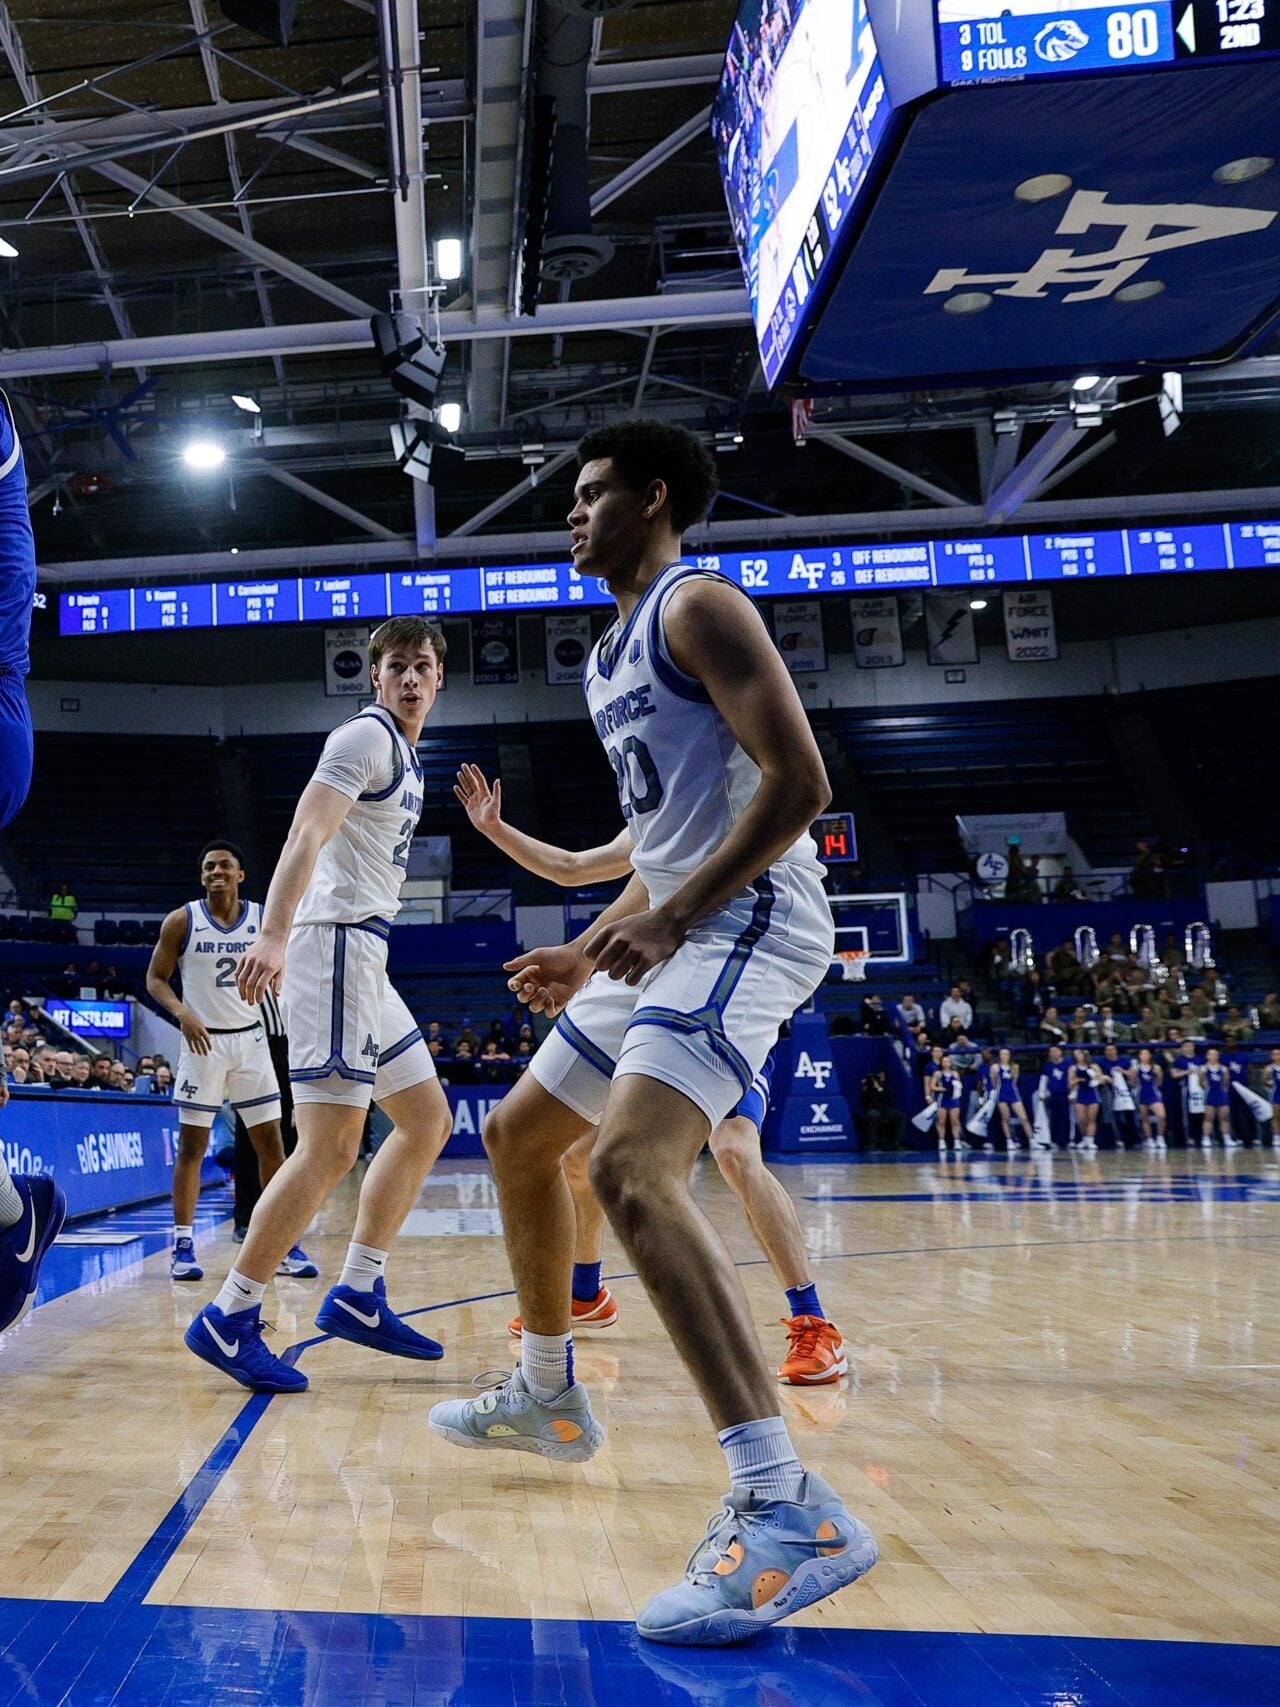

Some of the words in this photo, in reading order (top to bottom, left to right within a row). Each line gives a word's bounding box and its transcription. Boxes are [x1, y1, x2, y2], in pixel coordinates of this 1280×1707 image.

[958, 24, 971, 46] 3
[976, 22, 1007, 45] TOL
[1106, 9, 1159, 59] 80
[1220, 23, 1261, 50] 2ND
[960, 51, 974, 72] 9
[978, 46, 1028, 71] FOULS
[833, 552, 841, 566] 3
[853, 551, 873, 564] OFF
[872, 547, 926, 563] REBOUNDS
[486, 572, 506, 585] OFF
[505, 569, 556, 584] REBOUNDS
[740, 559, 769, 588] 52
[787, 554, 826, 590] AF
[855, 569, 873, 583] DEF
[875, 566, 929, 582] REBOUNDS
[488, 590, 505, 604] DEF
[507, 587, 558, 603] REBOUNDS
[777, 613, 819, 623] FORCE
[852, 608, 894, 618] FORCE
[1008, 605, 1050, 618] FORCE
[326, 639, 368, 648] FORCE
[474, 628, 514, 637] FORCE
[606, 684, 657, 732] FORCE
[824, 832, 848, 856] 14
[194, 942, 215, 954] AIR
[218, 940, 255, 954] FORC
[794, 1050, 833, 1089] AF
[180, 1079, 198, 1099] AF
[452, 1099, 501, 1135] AI
[76, 1133, 100, 1175] BIG
[99, 1132, 144, 1172] SAVINGS!
